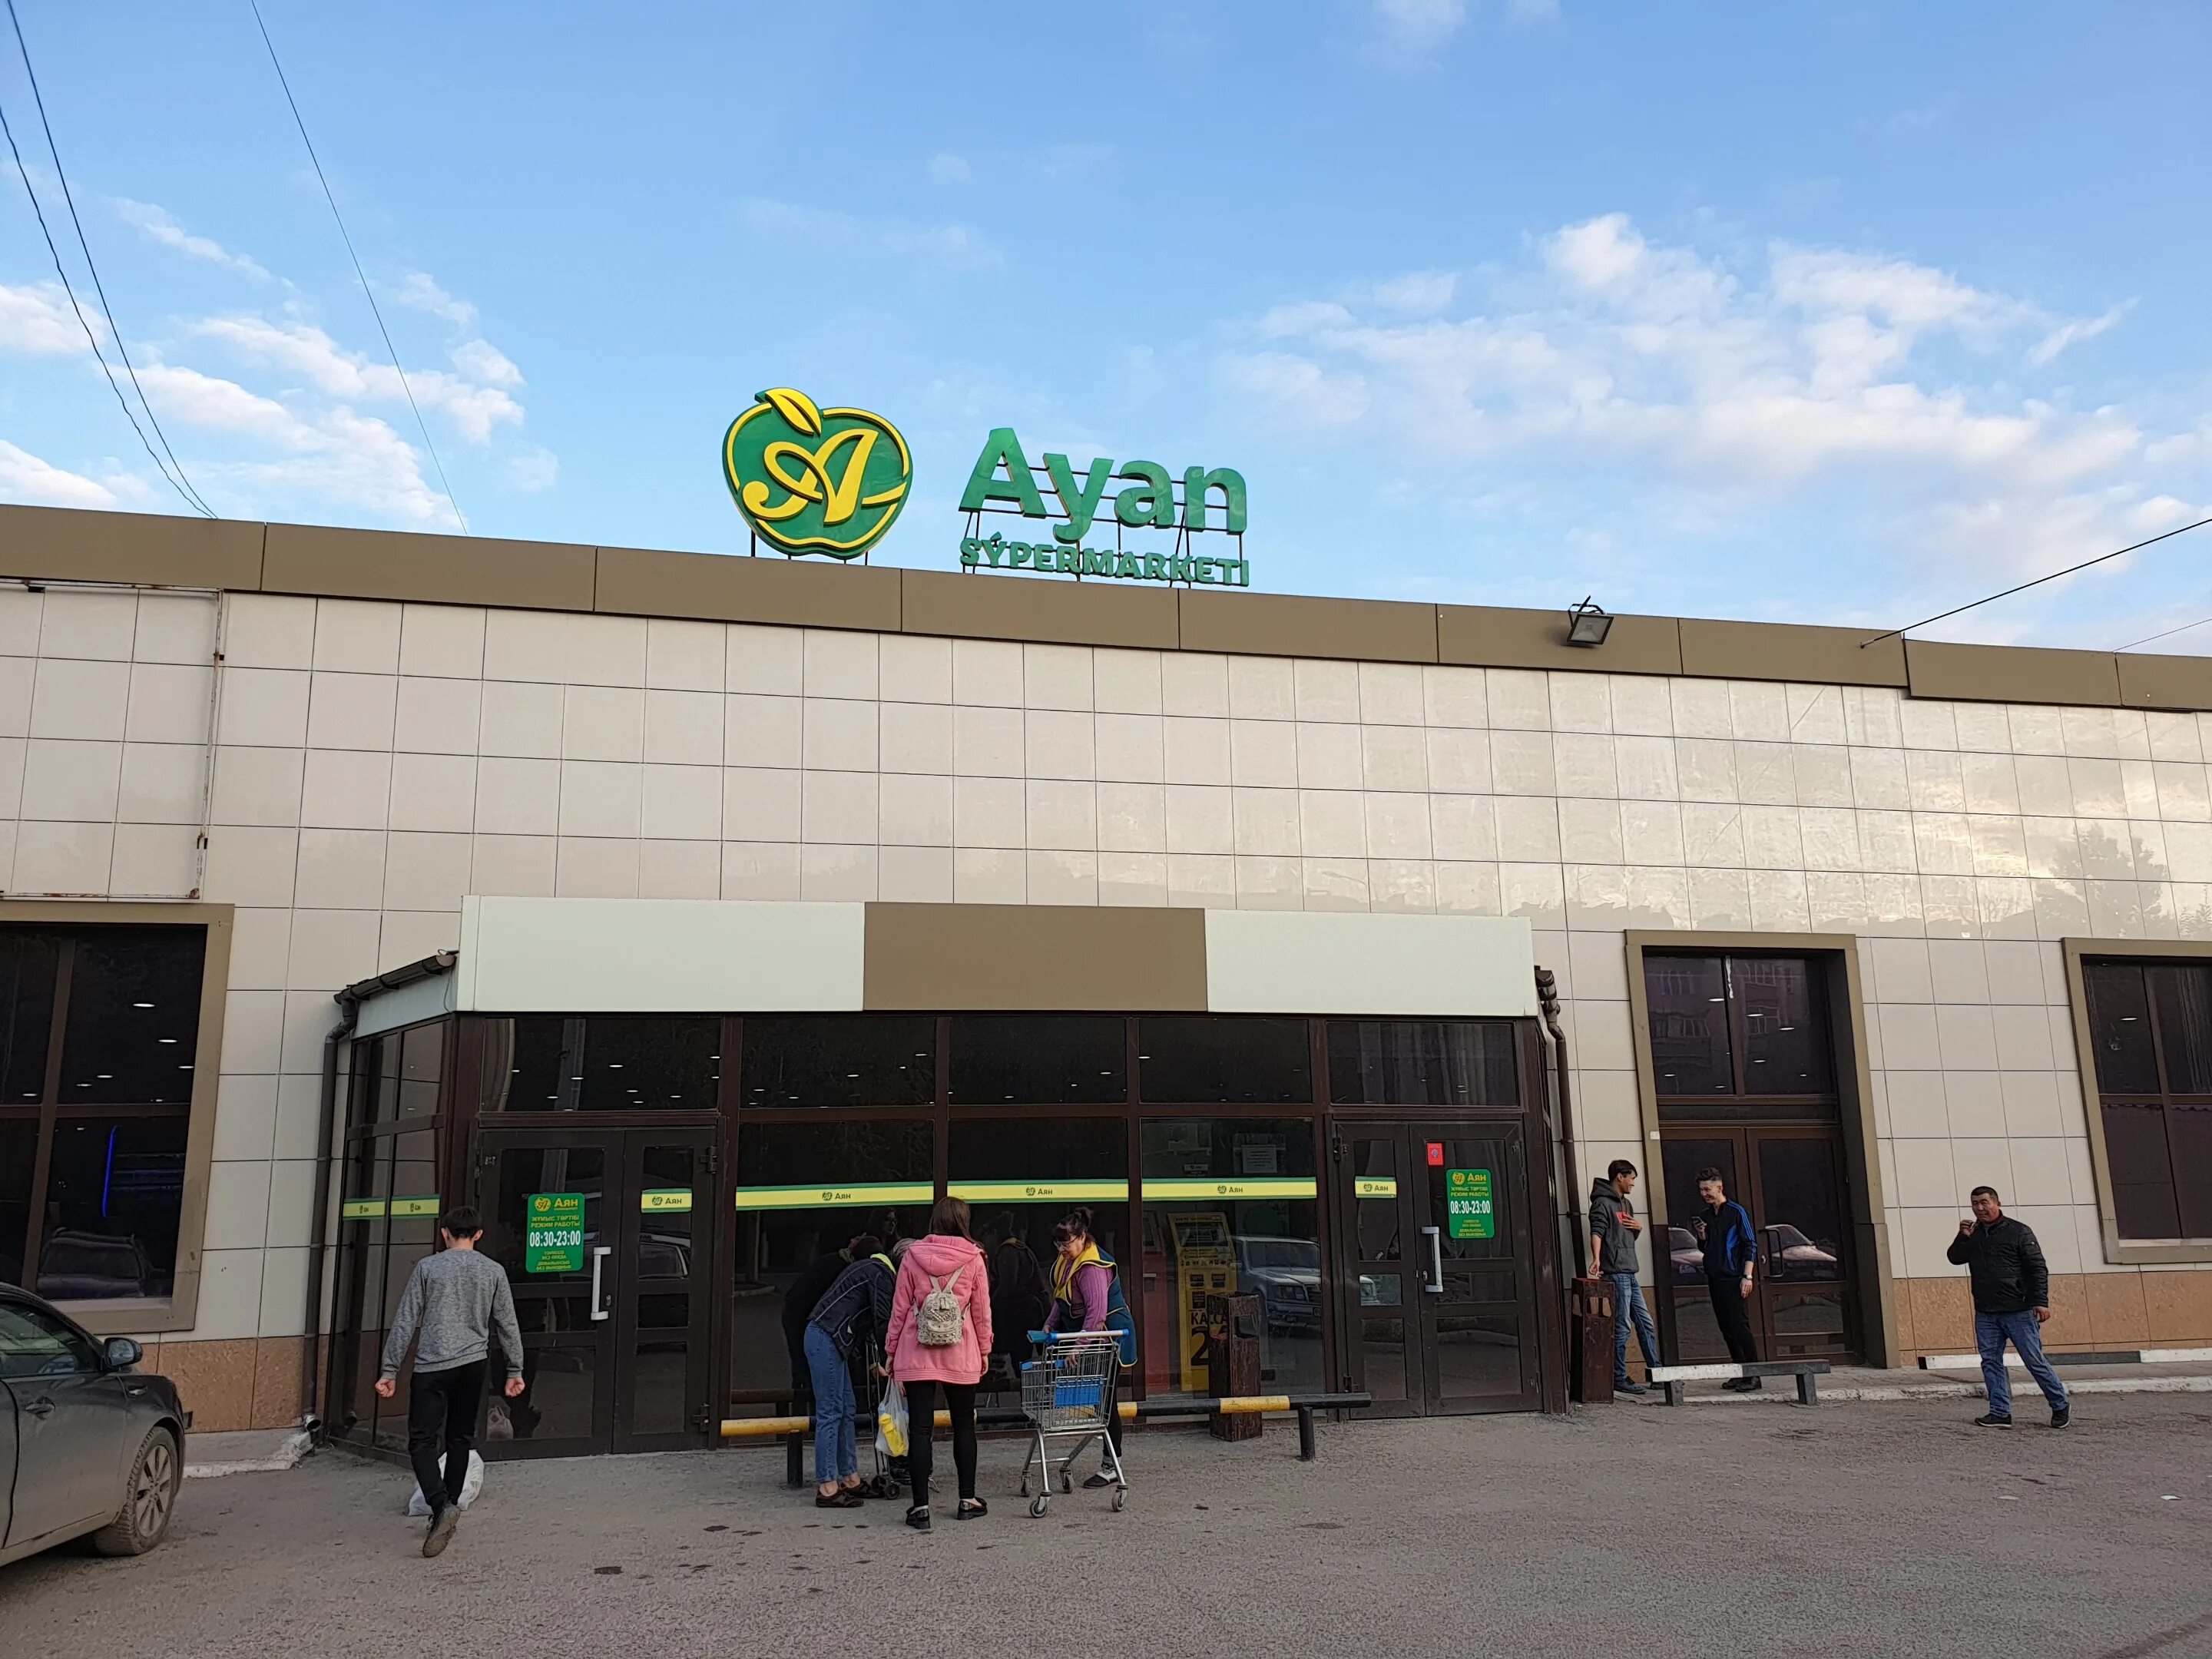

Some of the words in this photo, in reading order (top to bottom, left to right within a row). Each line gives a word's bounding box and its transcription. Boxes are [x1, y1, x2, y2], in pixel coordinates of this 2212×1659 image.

[959, 428, 1247, 544] Ayan
[1467, 1172, 1487, 1181] Аян
[554, 1197, 578, 1207] Аян
[1450, 1200, 1491, 1214] 08:30-23:00
[529, 1230, 581, 1247] 08:30-23:00
